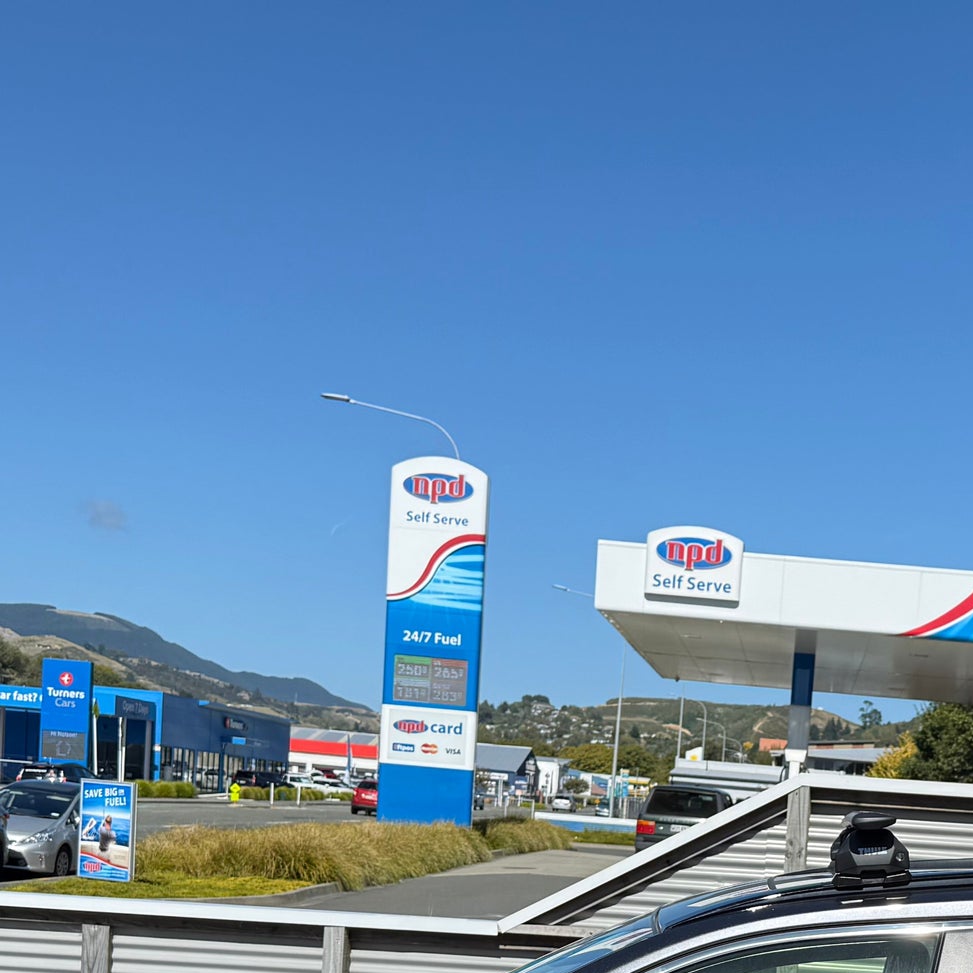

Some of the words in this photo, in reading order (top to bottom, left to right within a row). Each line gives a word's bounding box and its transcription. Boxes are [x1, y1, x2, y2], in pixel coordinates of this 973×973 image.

[412, 474, 465, 504] npd
[406, 510, 431, 523] Self
[433, 513, 469, 526] Serve
[666, 538, 724, 571] npd
[652, 573, 684, 589] Self
[686, 576, 732, 593] Serve
[402, 629, 432, 643] 24/7
[434, 632, 462, 646] Fuel
[13, 690, 38, 702] fast?
[46, 686, 85, 700] Turners
[55, 698, 76, 709] Cars
[398, 719, 425, 734] npd
[430, 722, 463, 735] card
[84, 788, 103, 798] SAVE
[104, 787, 118, 797] BIG
[104, 796, 127, 807] FUEL!
